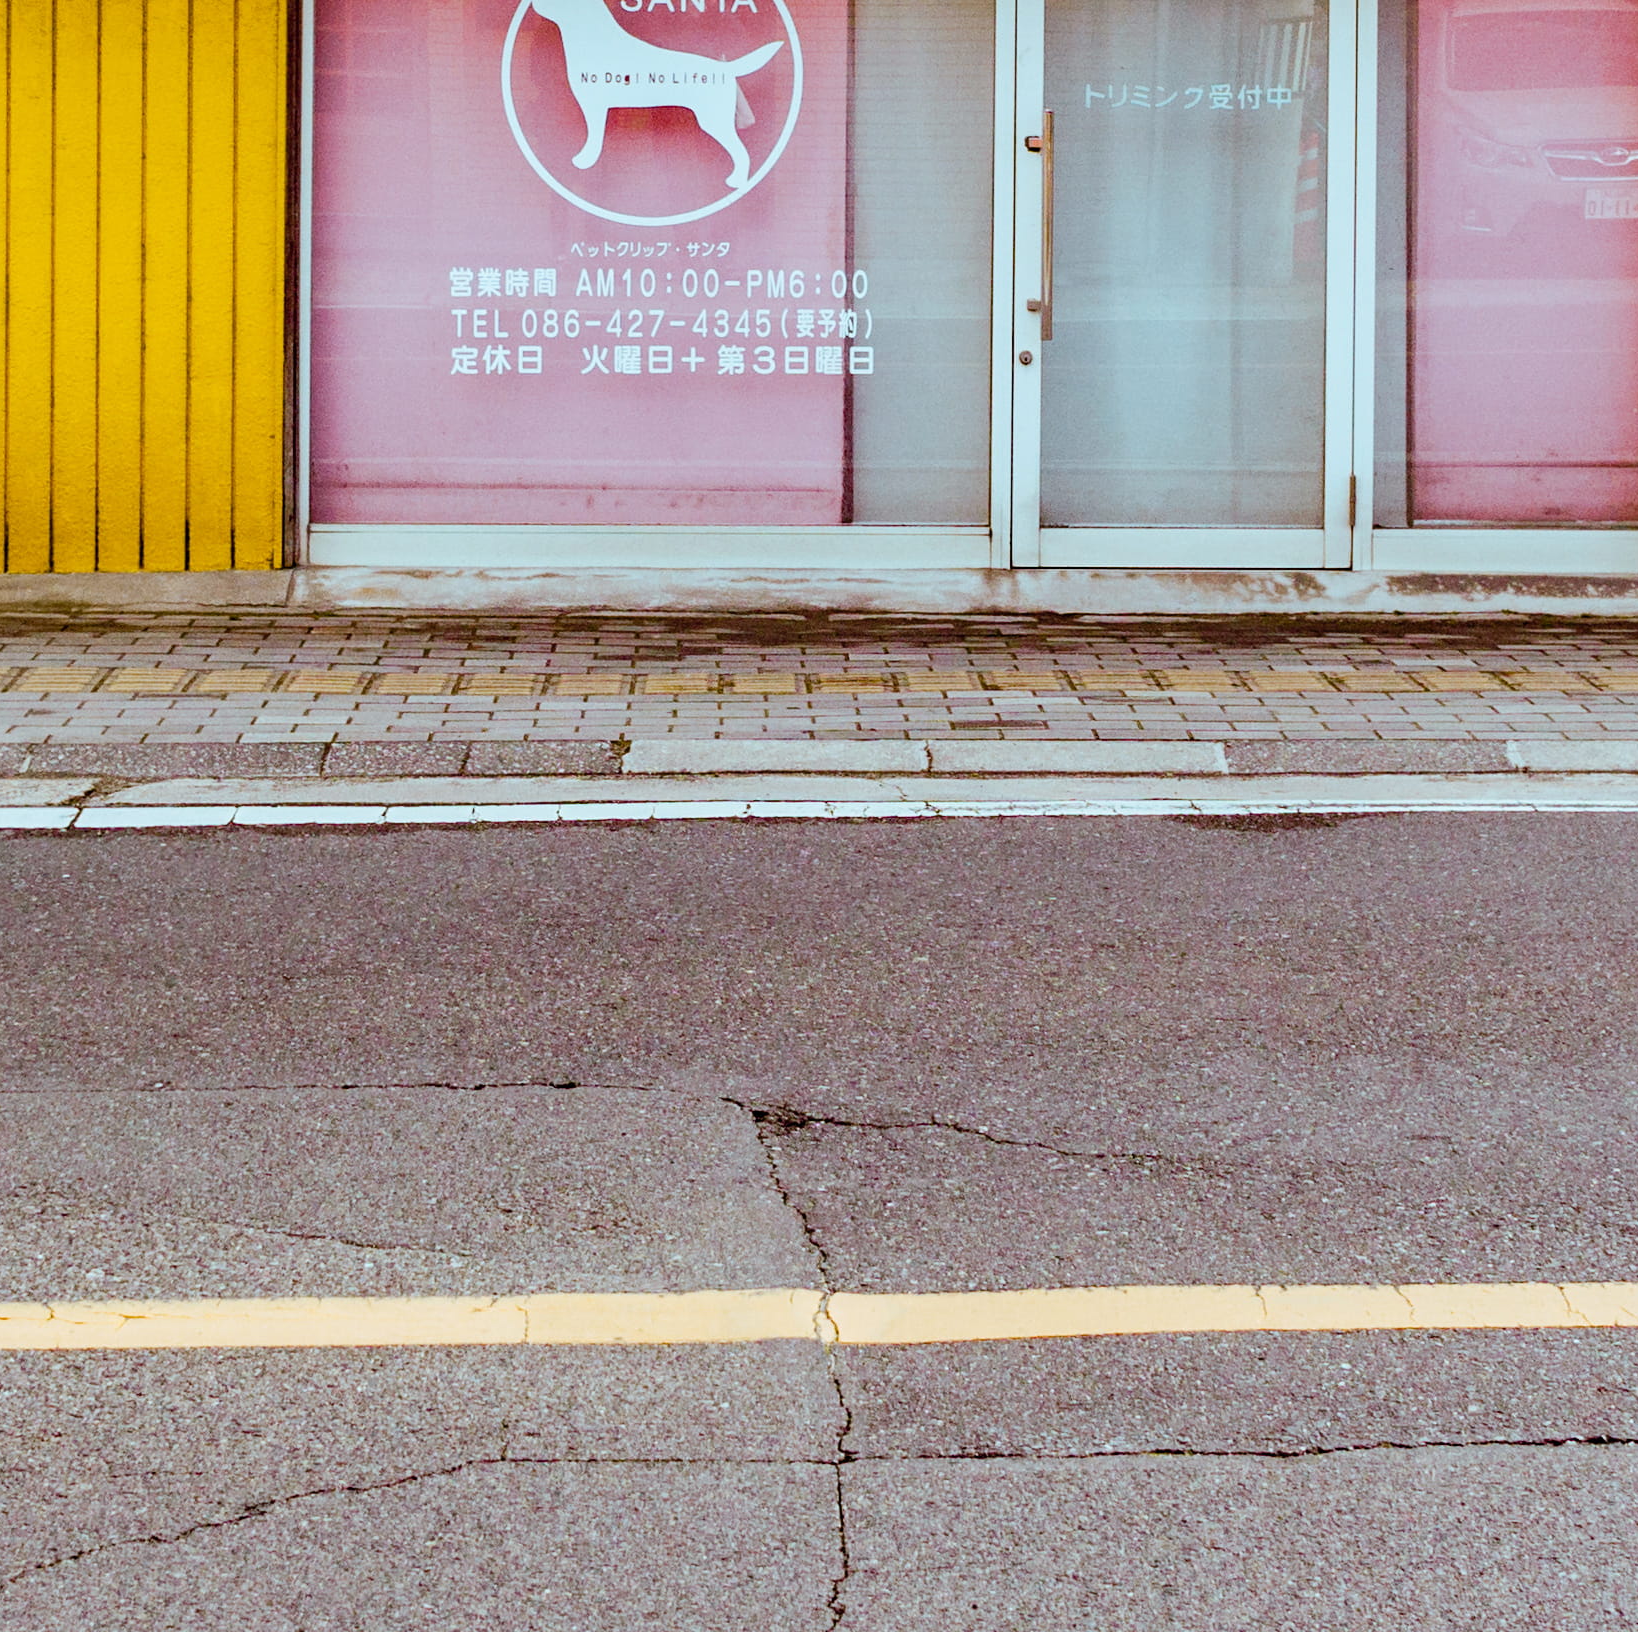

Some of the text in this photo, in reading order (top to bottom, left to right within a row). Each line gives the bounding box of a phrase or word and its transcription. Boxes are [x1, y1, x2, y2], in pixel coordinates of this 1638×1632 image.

[580, 72, 598, 84] No
[648, 72, 665, 84] No
[449, 267, 557, 298] 営業時間
[450, 309, 509, 338] TEL
[450, 344, 543, 375] 定休日
